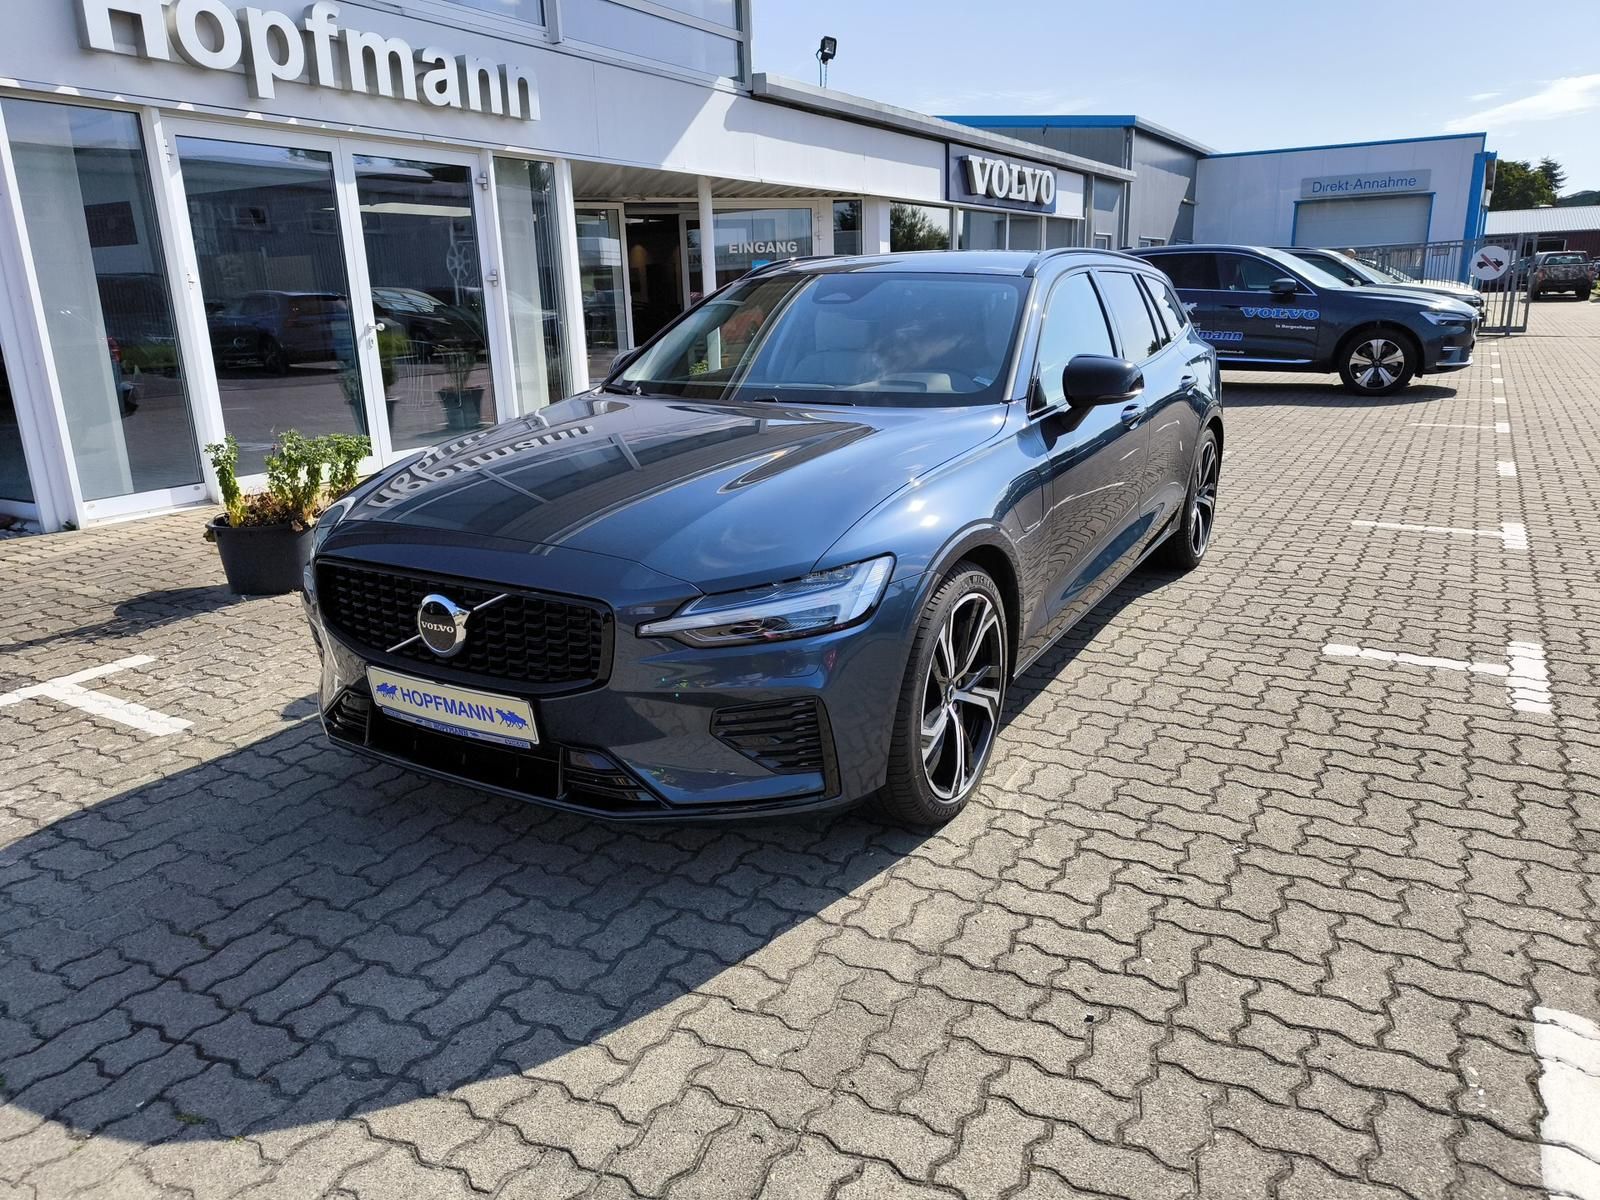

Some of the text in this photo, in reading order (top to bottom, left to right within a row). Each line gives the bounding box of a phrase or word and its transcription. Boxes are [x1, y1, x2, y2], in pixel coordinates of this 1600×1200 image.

[78, 0, 541, 122] Hopfmann
[962, 154, 1056, 206] VOLVO
[1311, 175, 1417, 193] Direkt-Annahme
[728, 241, 798, 254] EINGANG
[1240, 307, 1320, 320] VOLVO
[421, 620, 455, 634] VOLVO
[399, 686, 495, 723] HOPFMANN
